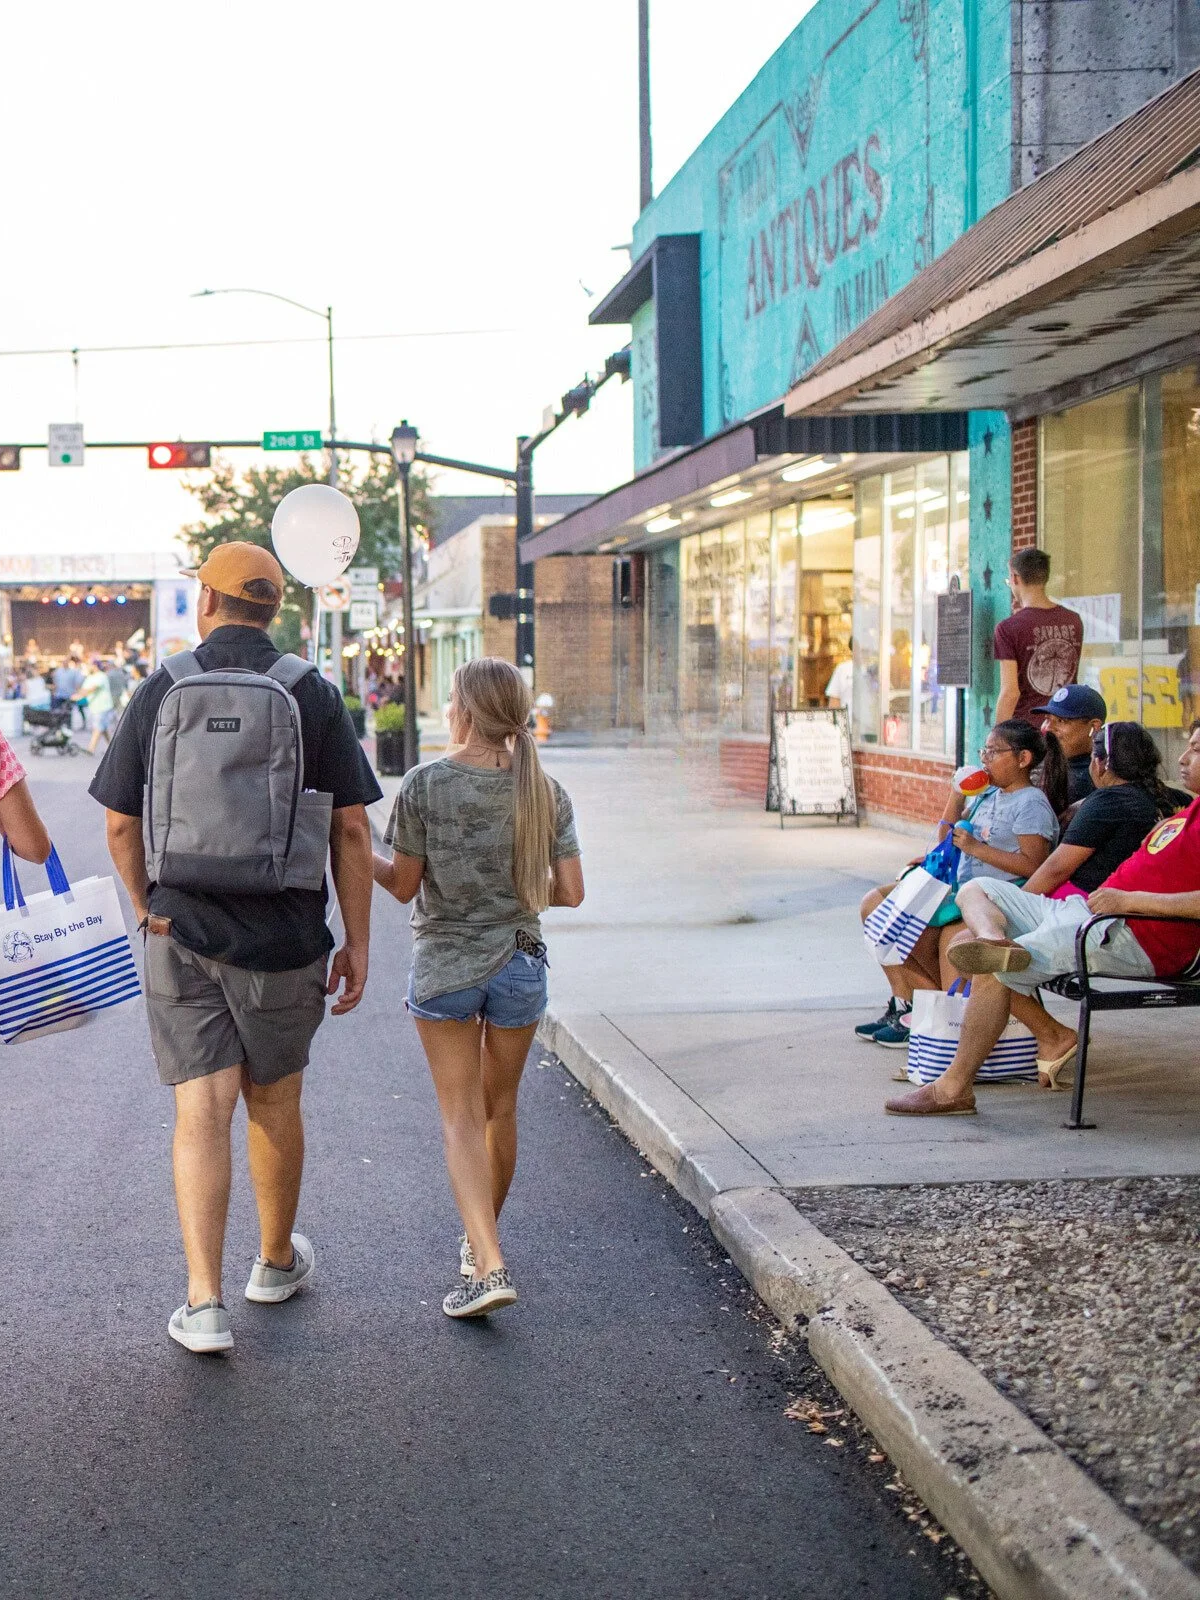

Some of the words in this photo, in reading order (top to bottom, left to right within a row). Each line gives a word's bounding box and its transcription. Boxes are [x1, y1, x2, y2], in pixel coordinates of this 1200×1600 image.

[744, 132, 883, 322] ANTIQUES
[270, 435, 296, 447] 2nd
[302, 434, 314, 446] St
[1033, 624, 1076, 644] SAVAGE
[211, 721, 236, 729] YETI
[33, 932, 54, 944] Stay
[54, 927, 67, 938] By
[68, 921, 85, 932] the
[85, 915, 103, 926] Bay
